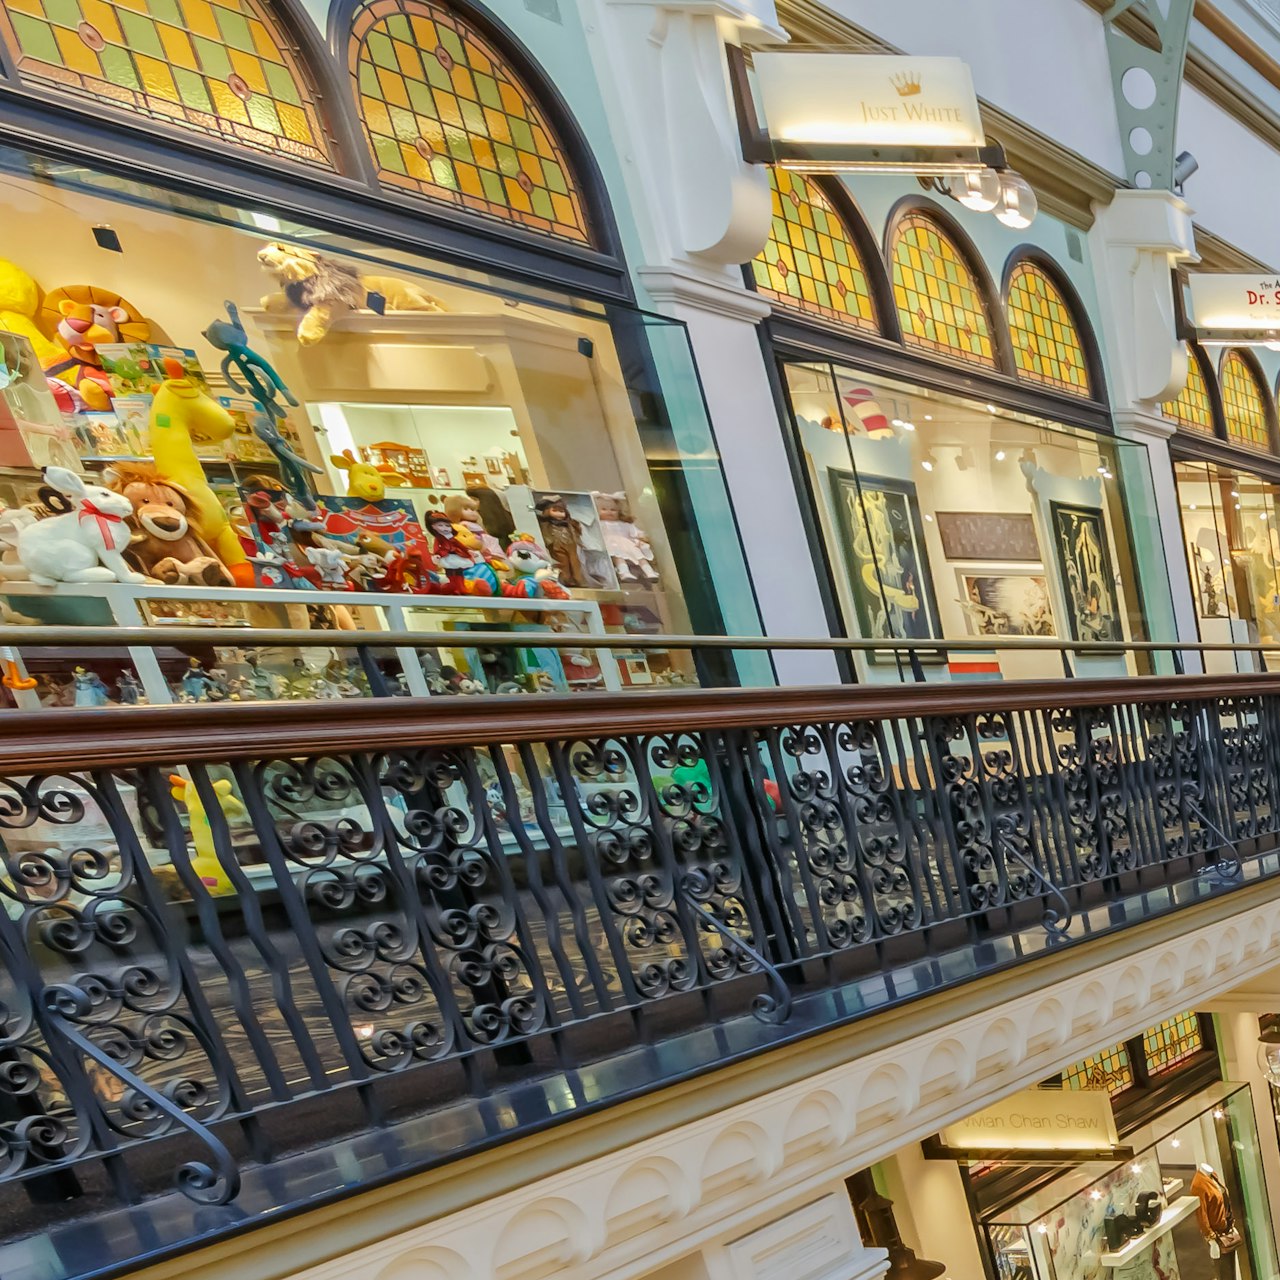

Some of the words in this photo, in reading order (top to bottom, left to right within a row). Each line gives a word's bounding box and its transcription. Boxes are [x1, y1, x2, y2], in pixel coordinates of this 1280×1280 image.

[1247, 290, 1269, 305] Dr.
[1009, 1113, 1052, 1129] Chan
[1055, 1113, 1099, 1129] Shaw
